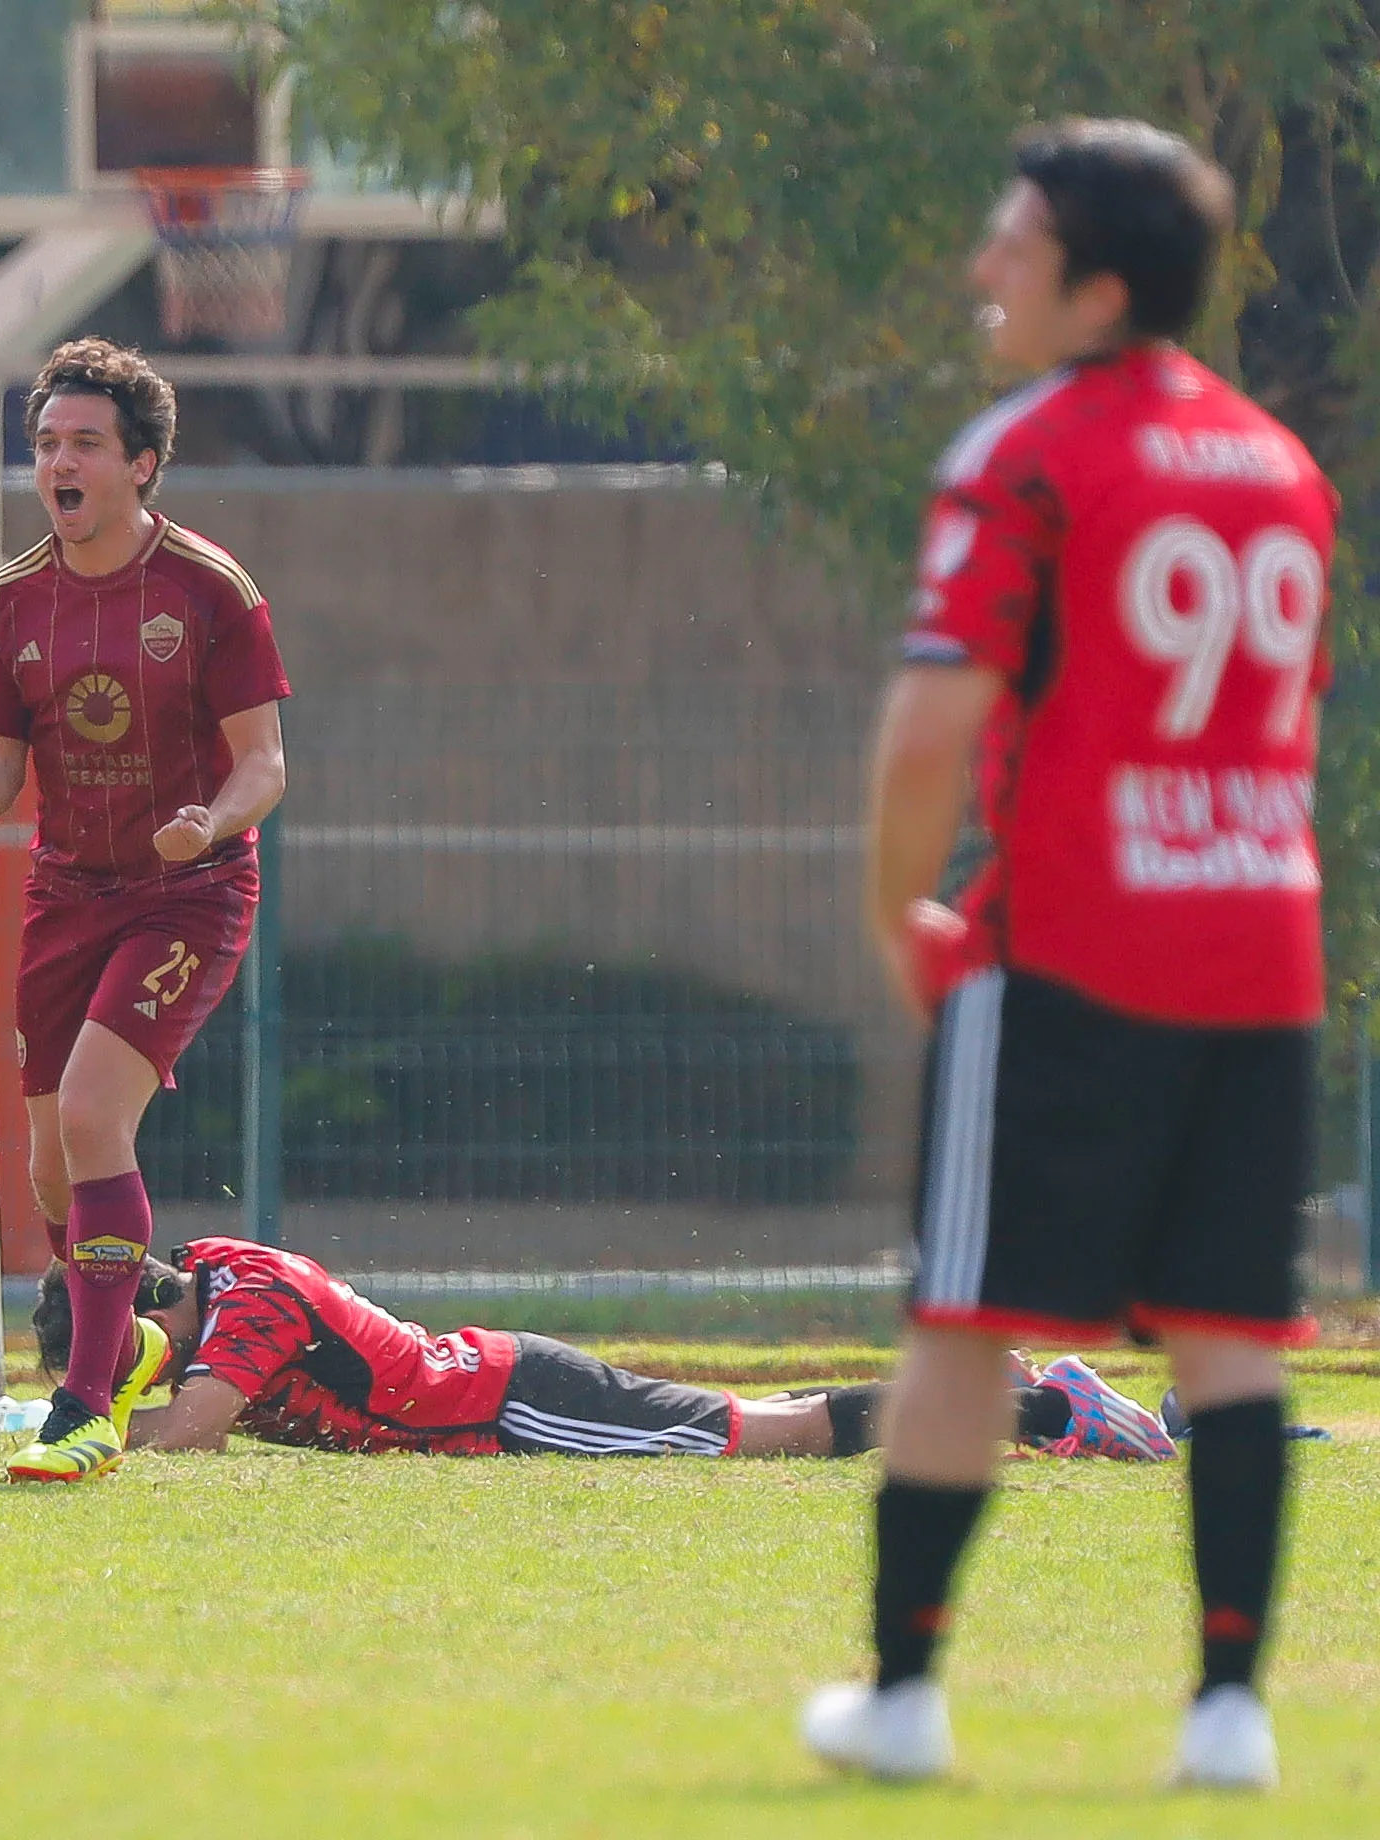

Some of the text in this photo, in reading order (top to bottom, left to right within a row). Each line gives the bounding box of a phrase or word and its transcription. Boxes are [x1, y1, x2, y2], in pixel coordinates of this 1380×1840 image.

[1123, 516, 1322, 741] 99
[142, 940, 201, 1005] 25
[79, 1262, 131, 1275] ROMA
